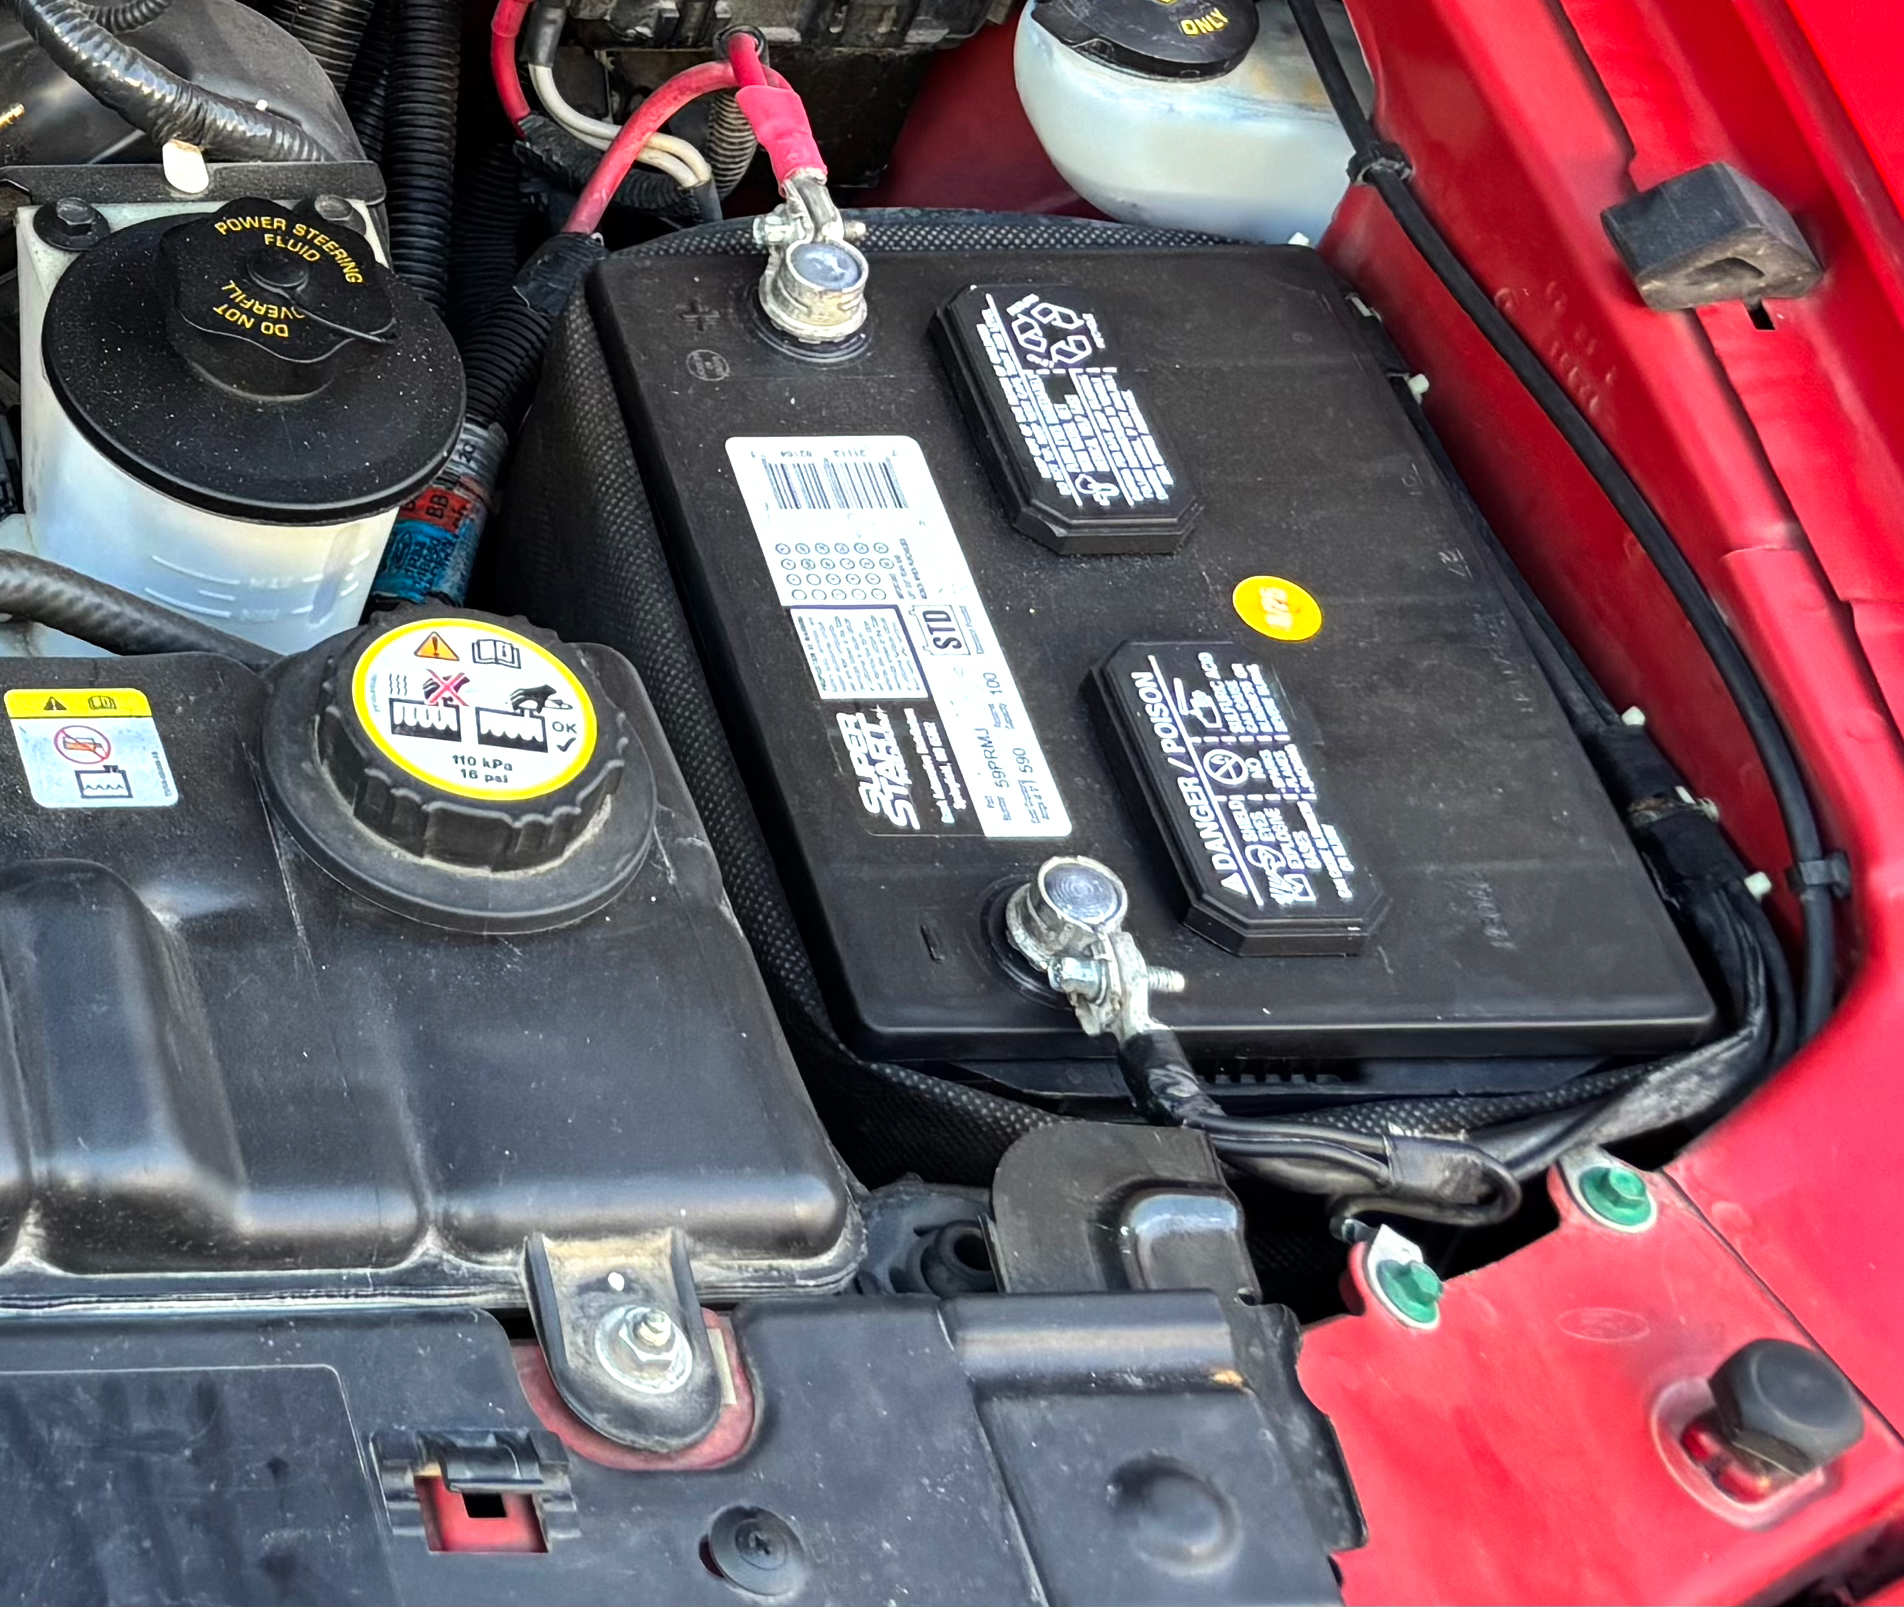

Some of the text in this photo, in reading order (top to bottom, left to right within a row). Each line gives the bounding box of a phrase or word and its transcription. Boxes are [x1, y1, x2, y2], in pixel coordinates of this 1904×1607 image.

[1180, 7, 1229, 36] ONLY
[214, 216, 365, 284] POWER STEERING
[264, 233, 322, 262] FLUID
[212, 303, 290, 338] DO NOT
[425, 494, 450, 519] BB
[922, 609, 964, 651] STD
[982, 671, 1004, 696] 100
[1197, 651, 1246, 734] SULFURIC ACID
[552, 720, 578, 735] OK
[452, 755, 514, 772] 110 kPa
[460, 768, 509, 784] 16 psi
[835, 712, 882, 815] SUPER
[855, 711, 921, 831] START
[973, 727, 1010, 790] 59PRMJ
[1012, 747, 1035, 775] 590
[1130, 670, 1239, 872] DANGER / POISON
[1244, 758, 1267, 779] NO
[1228, 799, 1258, 843] SHIELD
[1249, 810, 1275, 843] EYES
[1263, 806, 1306, 870] EXPLOSIVE
[1292, 830, 1323, 870] GASES
